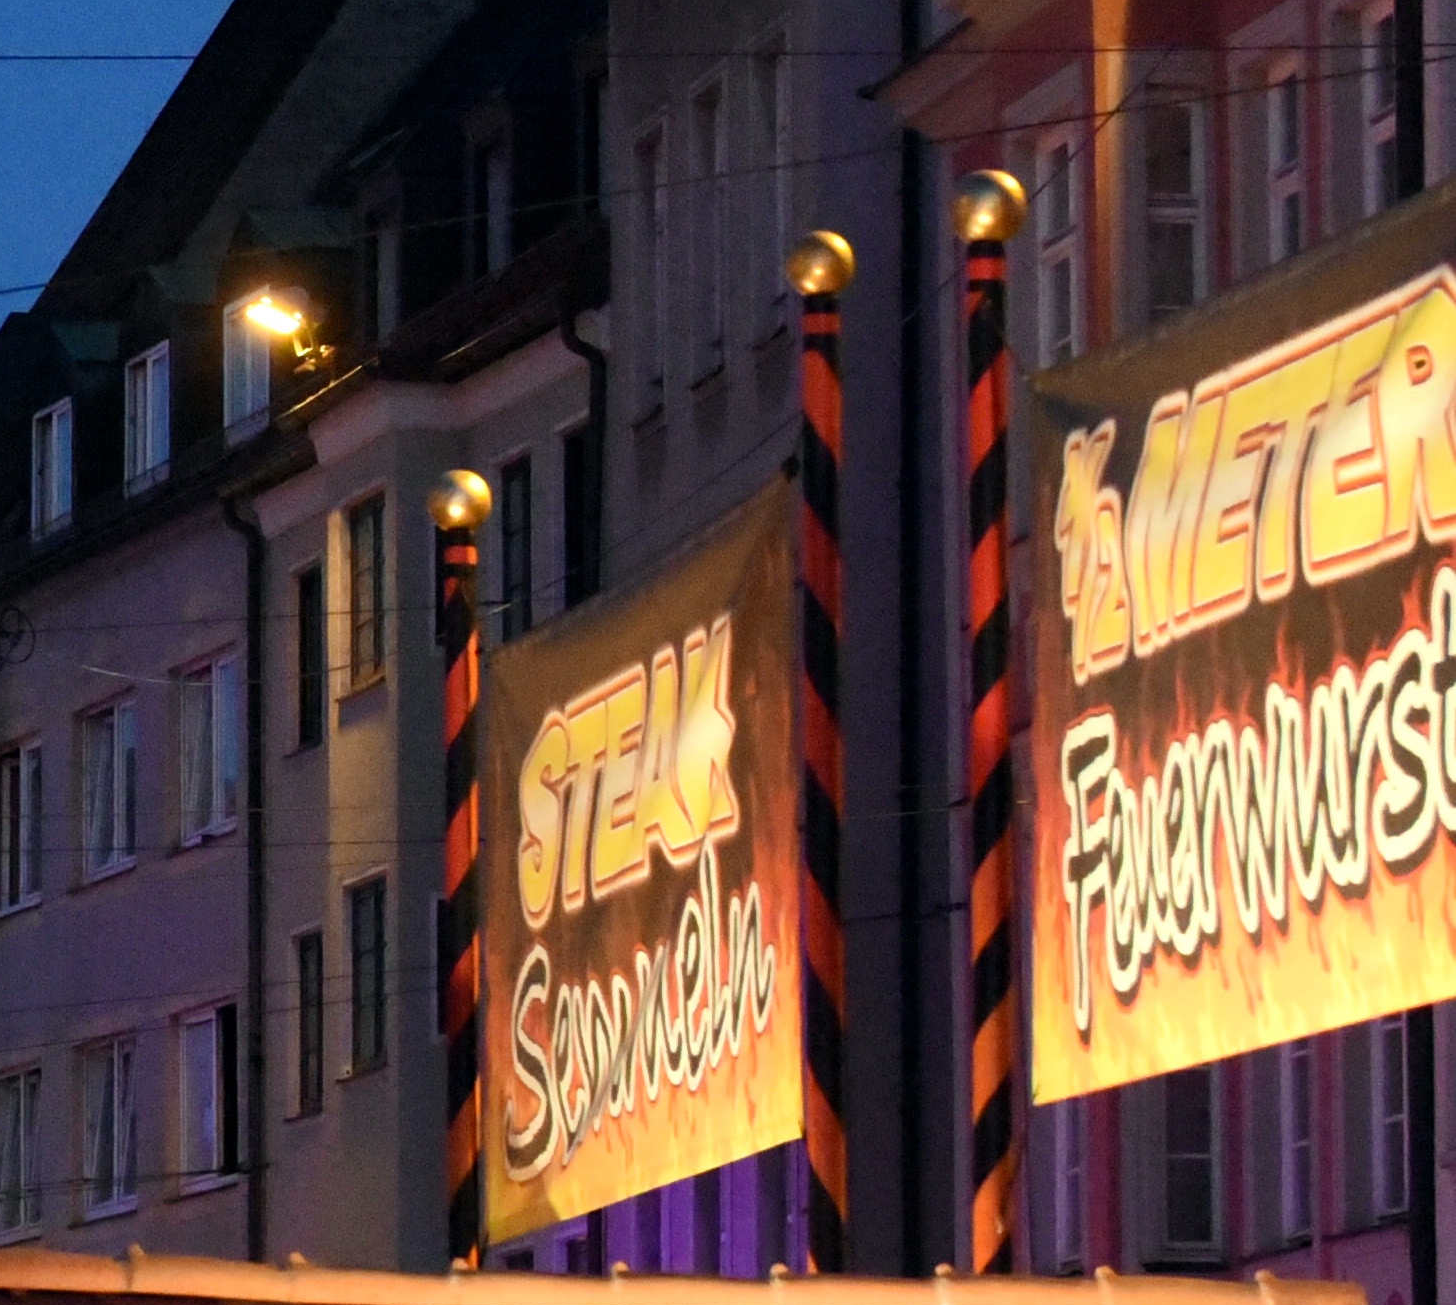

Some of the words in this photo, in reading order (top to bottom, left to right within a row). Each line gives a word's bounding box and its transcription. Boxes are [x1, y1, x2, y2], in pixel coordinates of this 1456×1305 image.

[1124, 262, 1456, 658] METER
[520, 613, 739, 928] STEAK
[503, 847, 775, 1182] Semmeln
